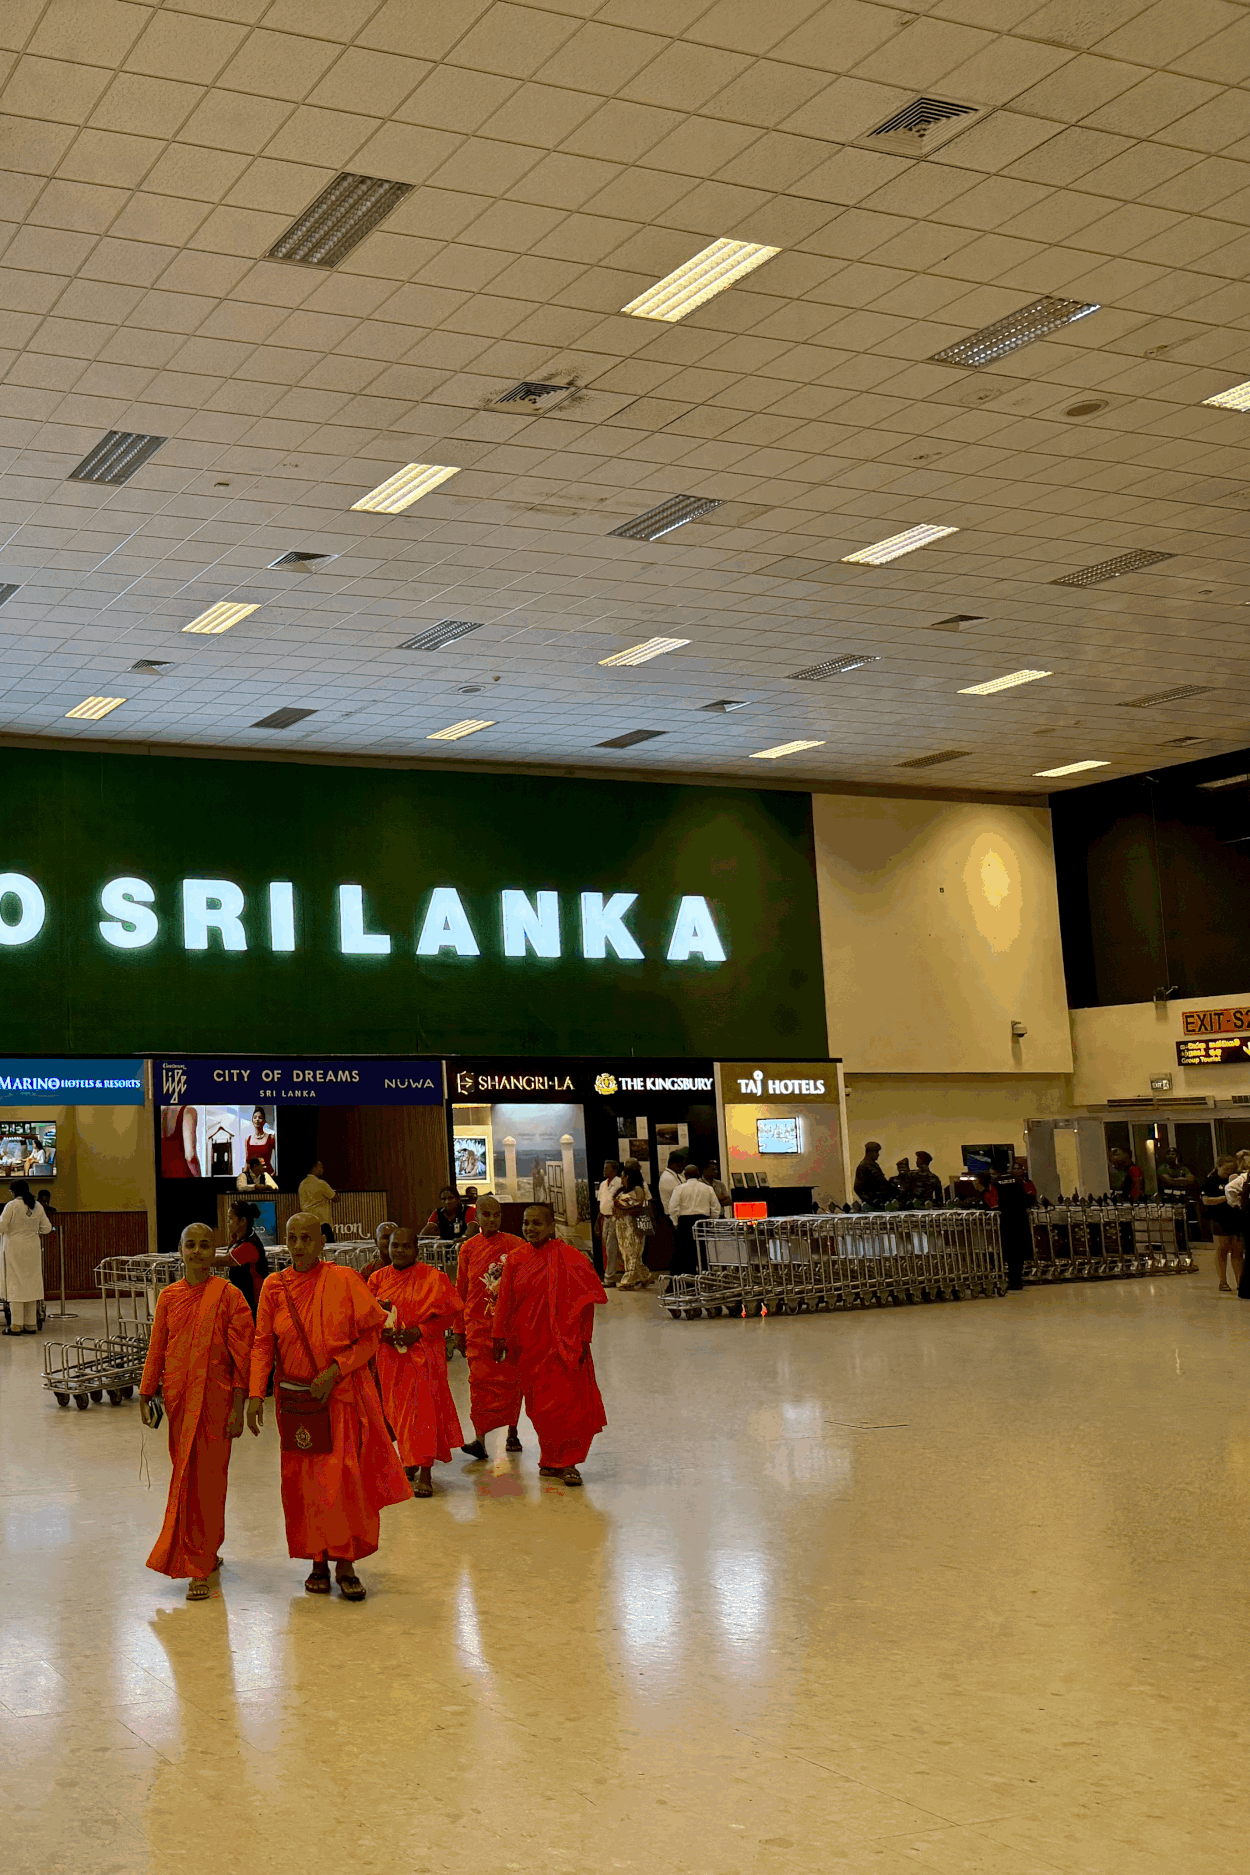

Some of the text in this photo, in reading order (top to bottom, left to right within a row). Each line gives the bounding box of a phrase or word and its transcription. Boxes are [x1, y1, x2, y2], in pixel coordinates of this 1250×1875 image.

[99, 878, 295, 951] SRI
[339, 885, 727, 962] LANKA
[1184, 1012, 1224, 1033] EXIT
[61, 1079, 94, 1088] HOTELS
[95, 1079, 103, 1088] &
[104, 1079, 141, 1088] RESORTS
[213, 1070, 360, 1082] CITY OF DREAMS
[619, 1077, 714, 1091] THE KINGSBURY
[737, 1071, 826, 1096] TAJ HOTELS
